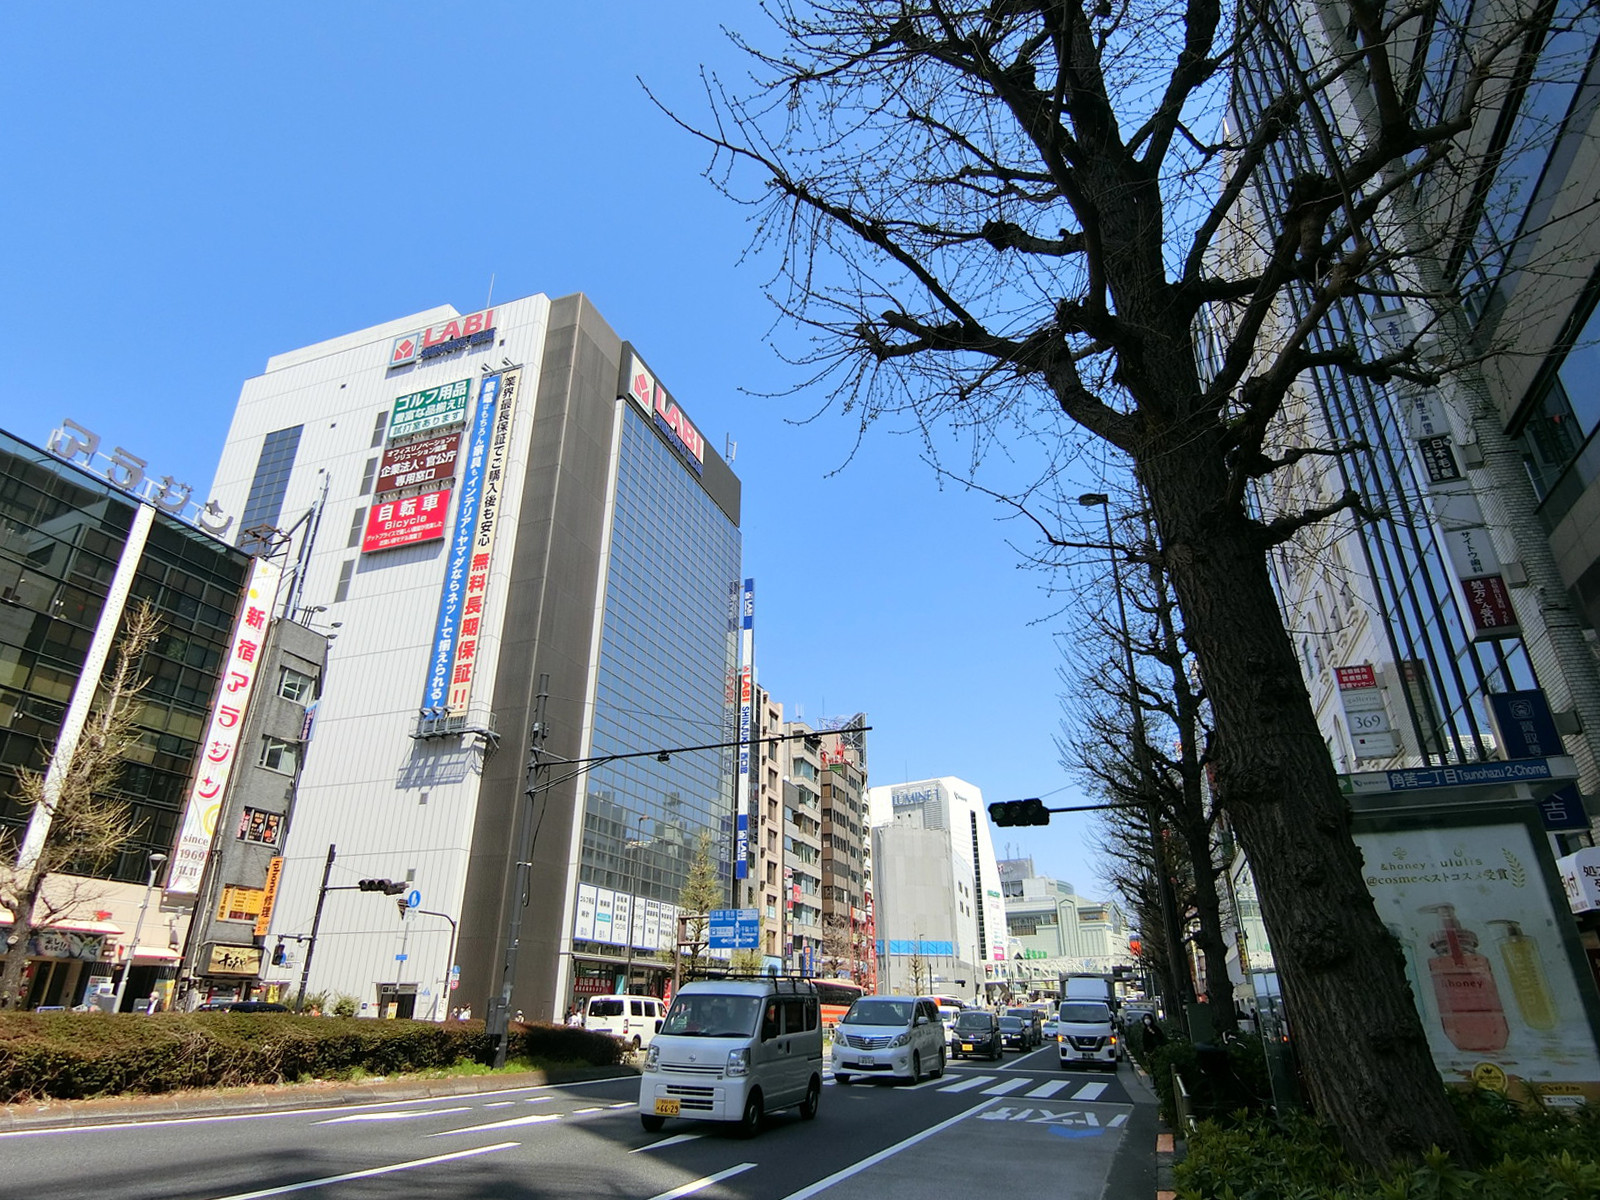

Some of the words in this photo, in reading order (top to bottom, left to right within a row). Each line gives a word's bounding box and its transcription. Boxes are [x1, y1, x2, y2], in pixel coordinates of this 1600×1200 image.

[422, 310, 494, 348] LABI
[396, 381, 467, 411] ゴルフ用品
[655, 383, 704, 463] LABI
[380, 450, 457, 478] 企業法人・官公庁
[395, 468, 436, 487] 専用窓口
[378, 494, 440, 522] 自転車
[385, 515, 427, 530] Bicycle
[1461, 531, 1483, 573] サイトウ歯科
[1470, 580, 1497, 627] 処方せん受付
[453, 553, 490, 709] 無料長期保証!!
[198, 606, 266, 798] 新宿アラジン
[741, 674, 751, 702] LABI
[1354, 714, 1381, 730] 369
[1391, 767, 1458, 788] 角筈二丁目
[1458, 766, 1504, 782] Tsunohazu
[1506, 764, 1547, 779] 2-Chome
[892, 789, 932, 806] LUMINE
[183, 833, 209, 847] since
[180, 849, 205, 861] 1969
[1381, 860, 1426, 872] &honey
[1439, 858, 1483, 869] ululis
[270, 860, 282, 894] iphone
[1366, 869, 1509, 887] @cosmeベストコスメ受賞
